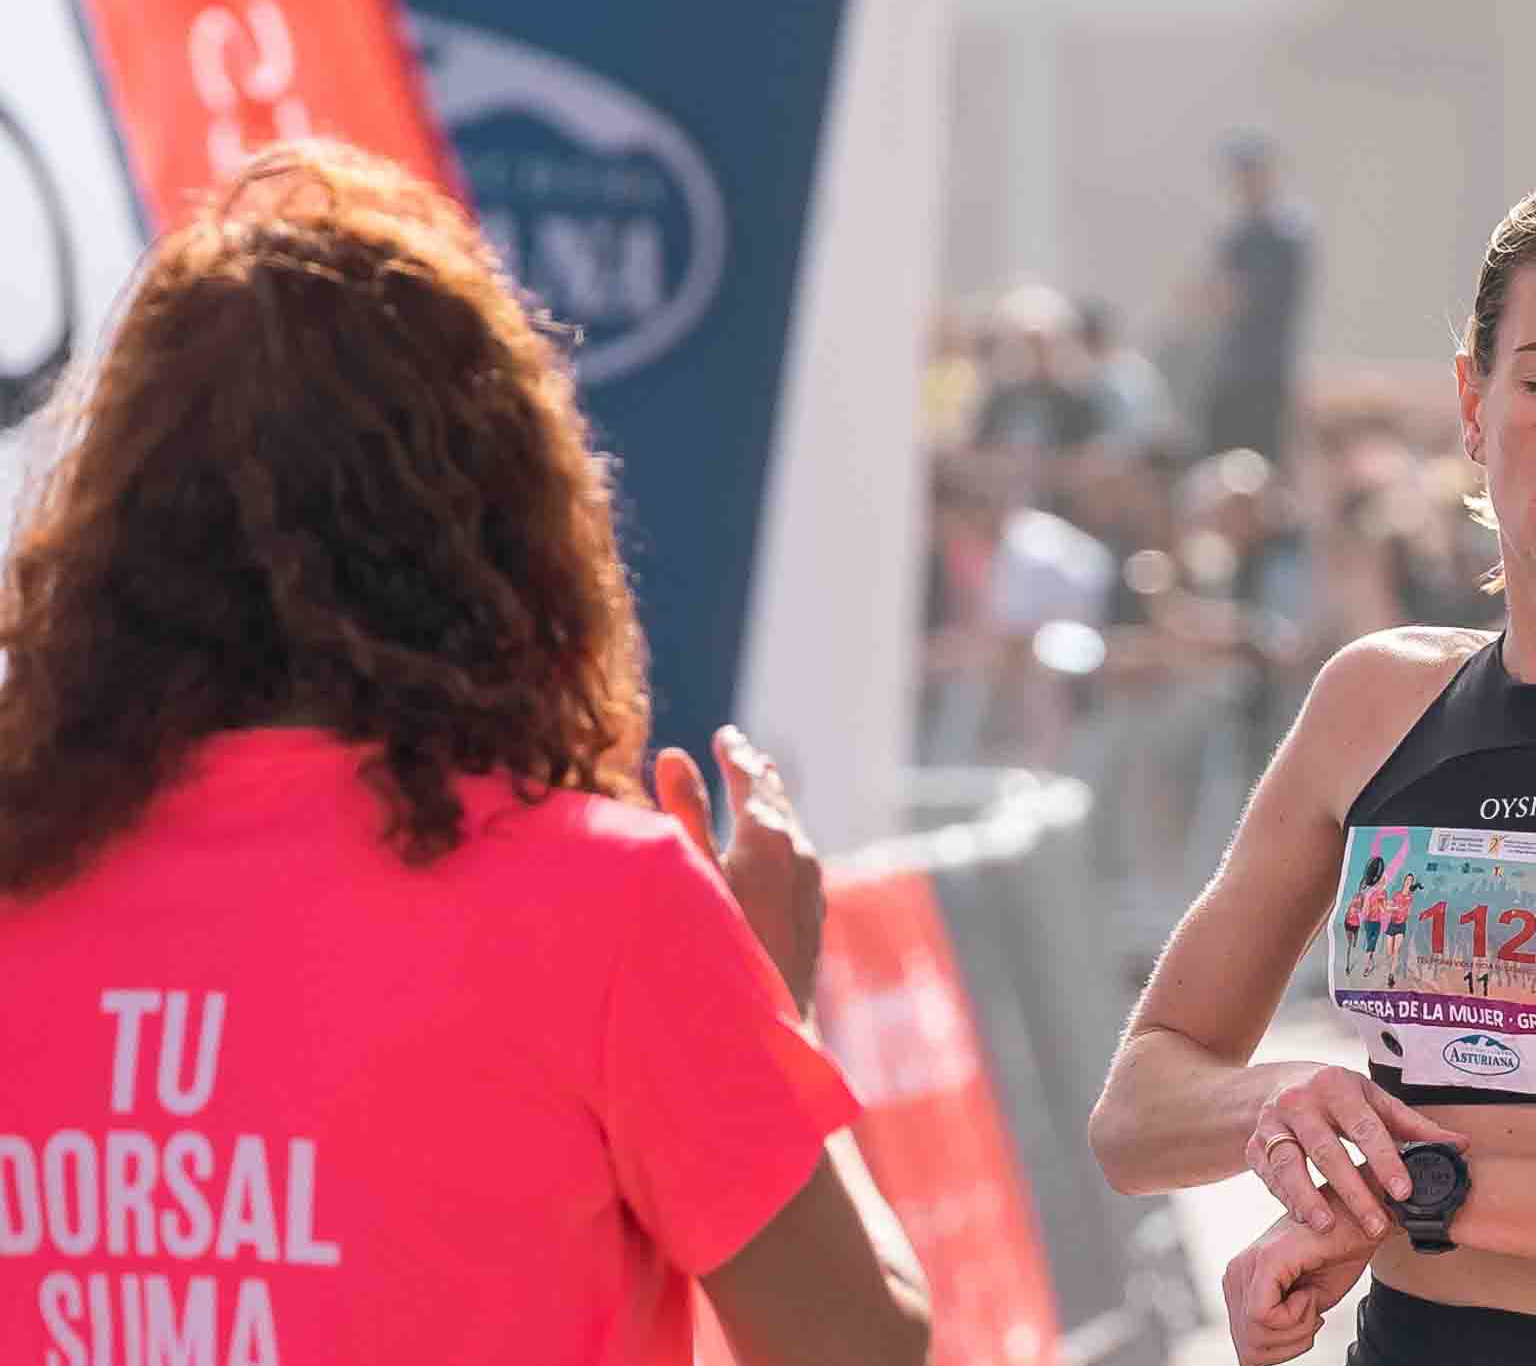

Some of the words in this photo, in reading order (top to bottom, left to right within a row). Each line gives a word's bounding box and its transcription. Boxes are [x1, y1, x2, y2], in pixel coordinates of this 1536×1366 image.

[1464, 972, 1489, 996] 11
[1398, 1000, 1419, 1018] DE
[1423, 1003, 1444, 1021] LA
[1449, 1004, 1504, 1028] MUJER
[100, 988, 226, 1117] TU
[1448, 1048, 1515, 1069] ASTURIANA
